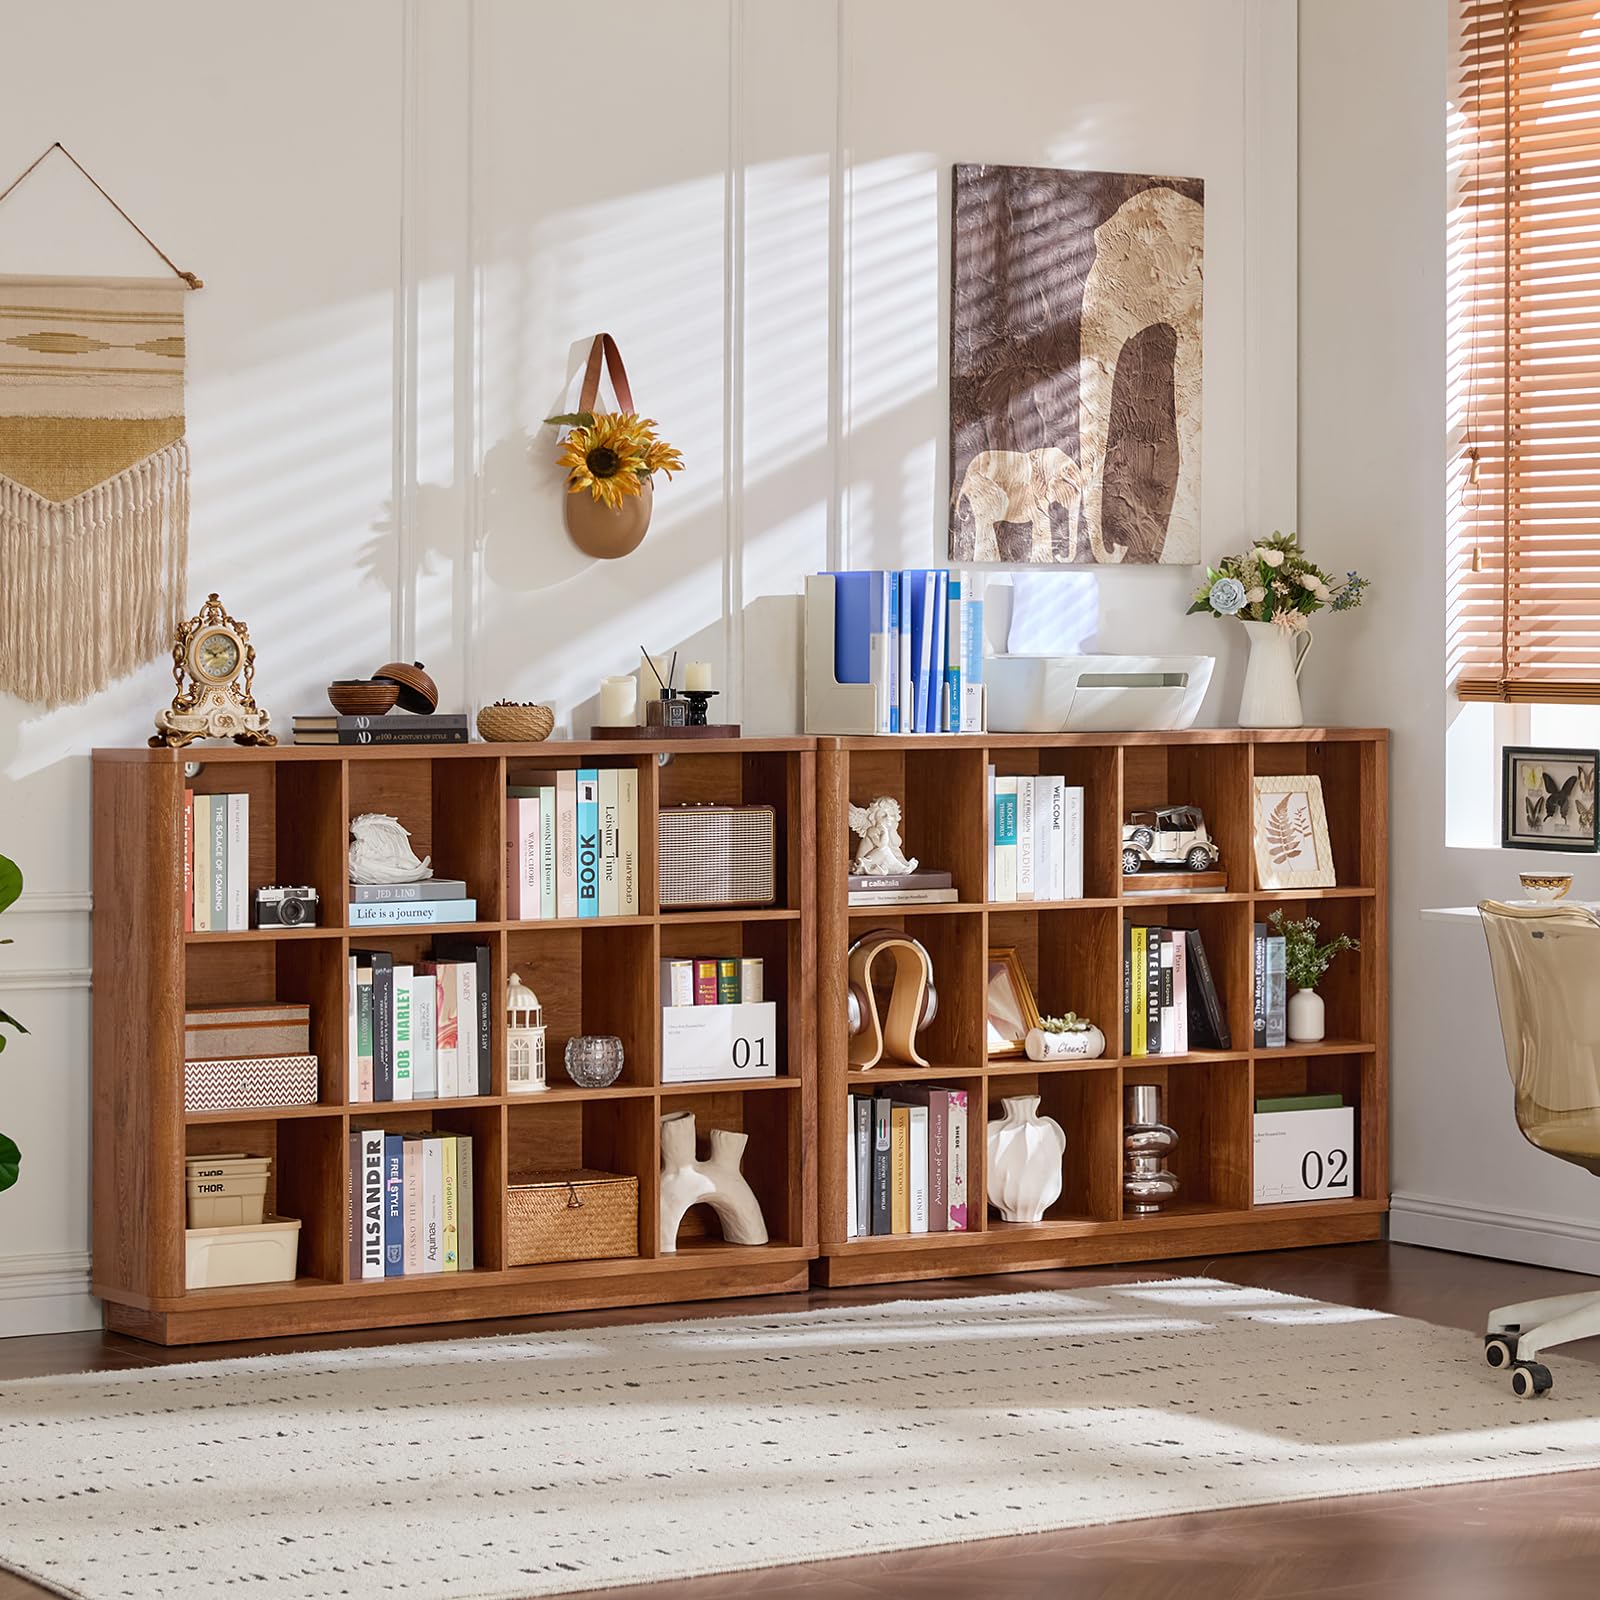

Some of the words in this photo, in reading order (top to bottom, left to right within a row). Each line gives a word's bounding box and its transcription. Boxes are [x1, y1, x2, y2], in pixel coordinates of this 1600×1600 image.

[355, 716, 370, 729] AD
[356, 732, 371, 743] AD
[1052, 786, 1060, 831] WELCOME
[606, 806, 615, 846] Leisure
[216, 860, 223, 870] OF
[580, 834, 596, 898] BOOK
[606, 852, 615, 881] Time
[1022, 836, 1030, 884] LEADING
[625, 850, 633, 904] GEOGRAPHIC
[376, 890, 391, 900] JED
[395, 888, 416, 898] LIND
[357, 909, 376, 918] Life
[380, 908, 386, 918] is
[396, 908, 434, 920] journey
[1150, 934, 1158, 986] LOVELY
[1176, 945, 1182, 953] In
[464, 971, 472, 1002] SIDNEY
[482, 992, 488, 1001] LO
[397, 988, 410, 1041] MARLEY
[1150, 991, 1158, 1023] HOME
[397, 1050, 410, 1079] BOB
[732, 1037, 769, 1069] 01
[934, 1158, 942, 1166] of
[1301, 1148, 1348, 1190] 02
[366, 1139, 382, 1266] JILSANDER
[390, 1186, 398, 1217] STYLE
[446, 1176, 454, 1221] Graduation
[428, 1222, 438, 1262] Aquinas
